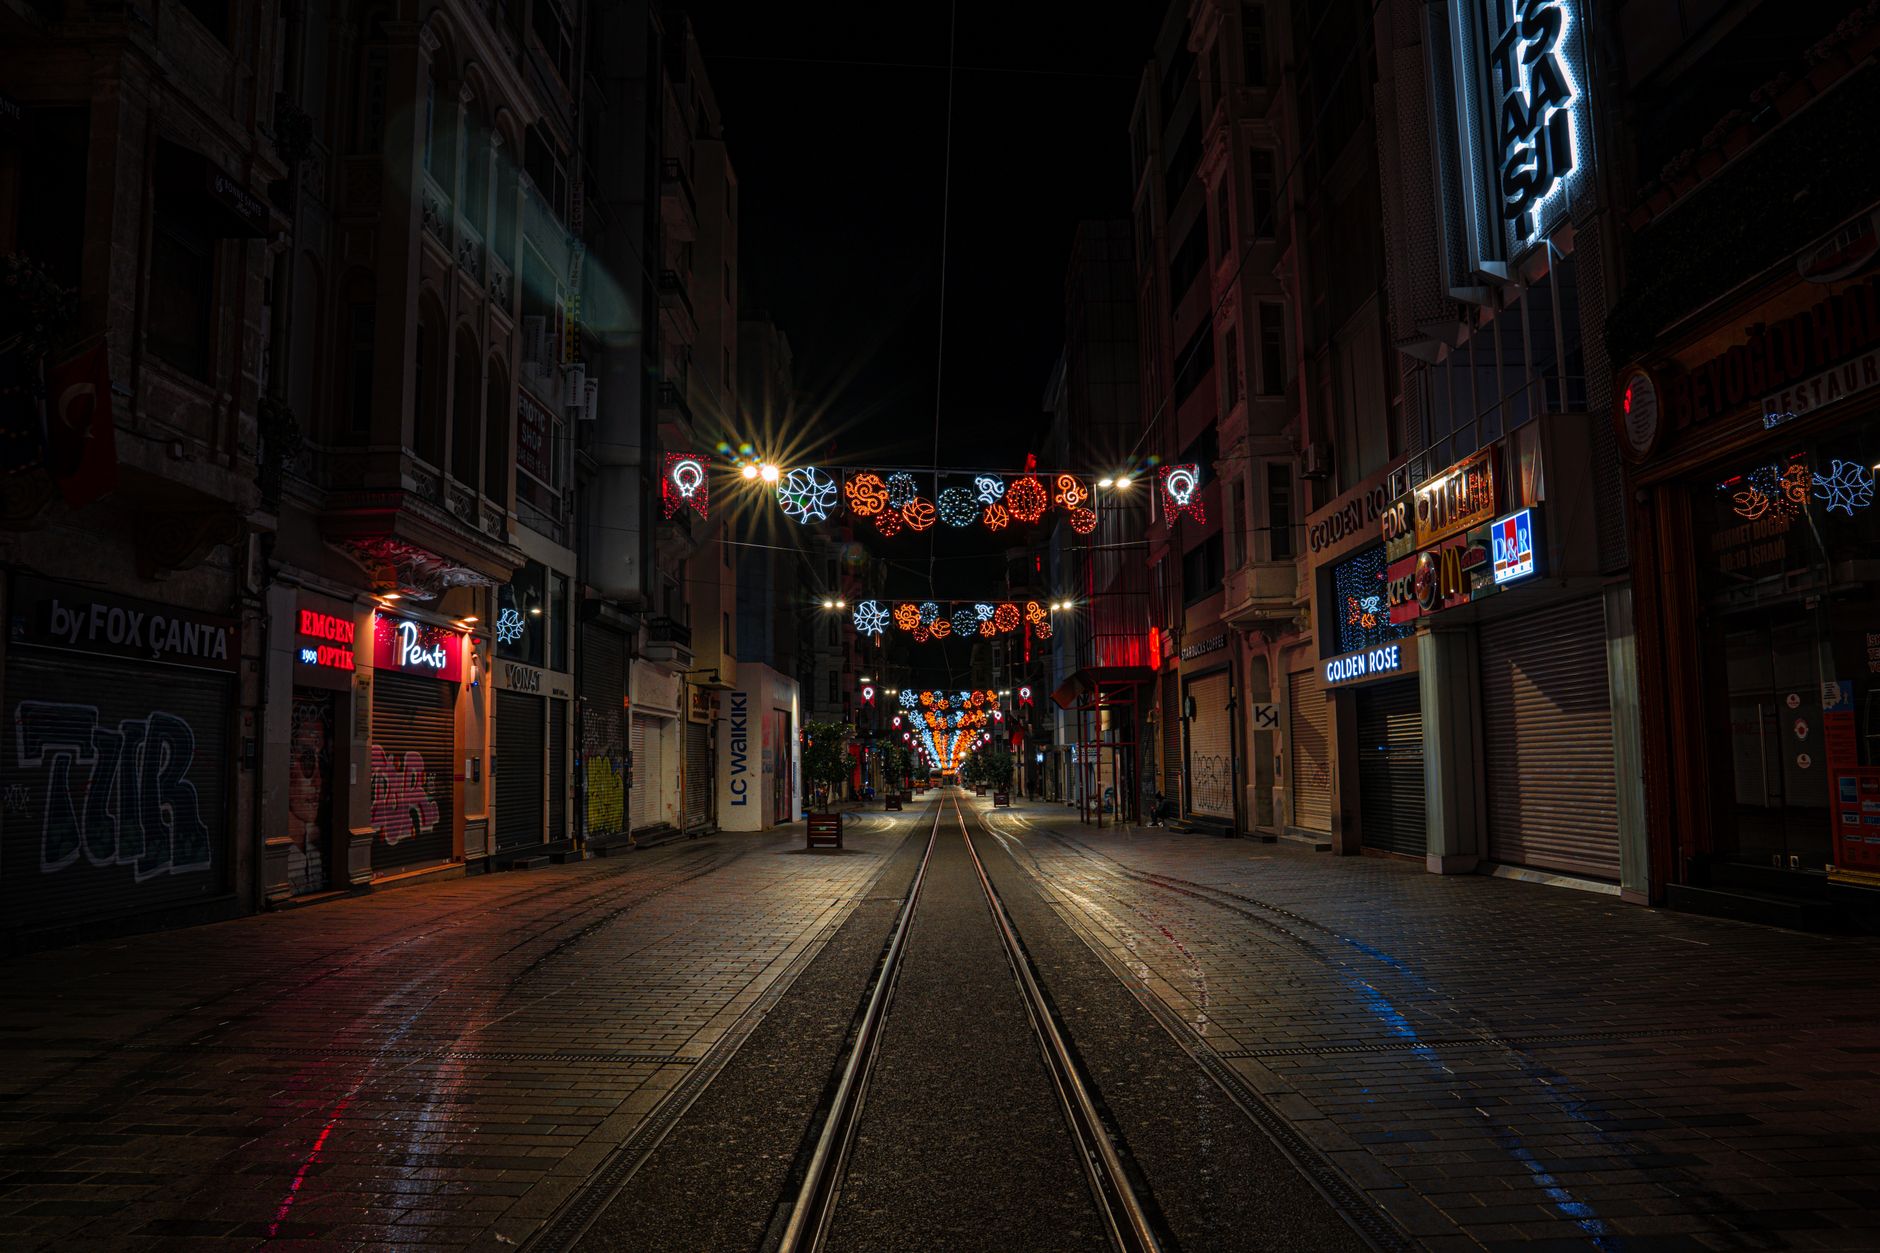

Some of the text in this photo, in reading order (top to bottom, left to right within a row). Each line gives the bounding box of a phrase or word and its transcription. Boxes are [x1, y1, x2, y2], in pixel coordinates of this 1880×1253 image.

[521, 423, 542, 451] SHOP
[1311, 498, 1363, 553] GOLDEN
[1494, 527, 1530, 563] D&R
[1386, 573, 1414, 607] KFC
[49, 599, 86, 644] by
[88, 603, 144, 648] FOX
[149, 615, 228, 661] ÇANTA
[300, 610, 355, 645] EMGEN
[400, 621, 447, 669] Penti
[301, 644, 355, 671] 1909 OPTİK
[1327, 645, 1399, 682] GOLDEN ROSE
[731, 779, 747, 806] LC
